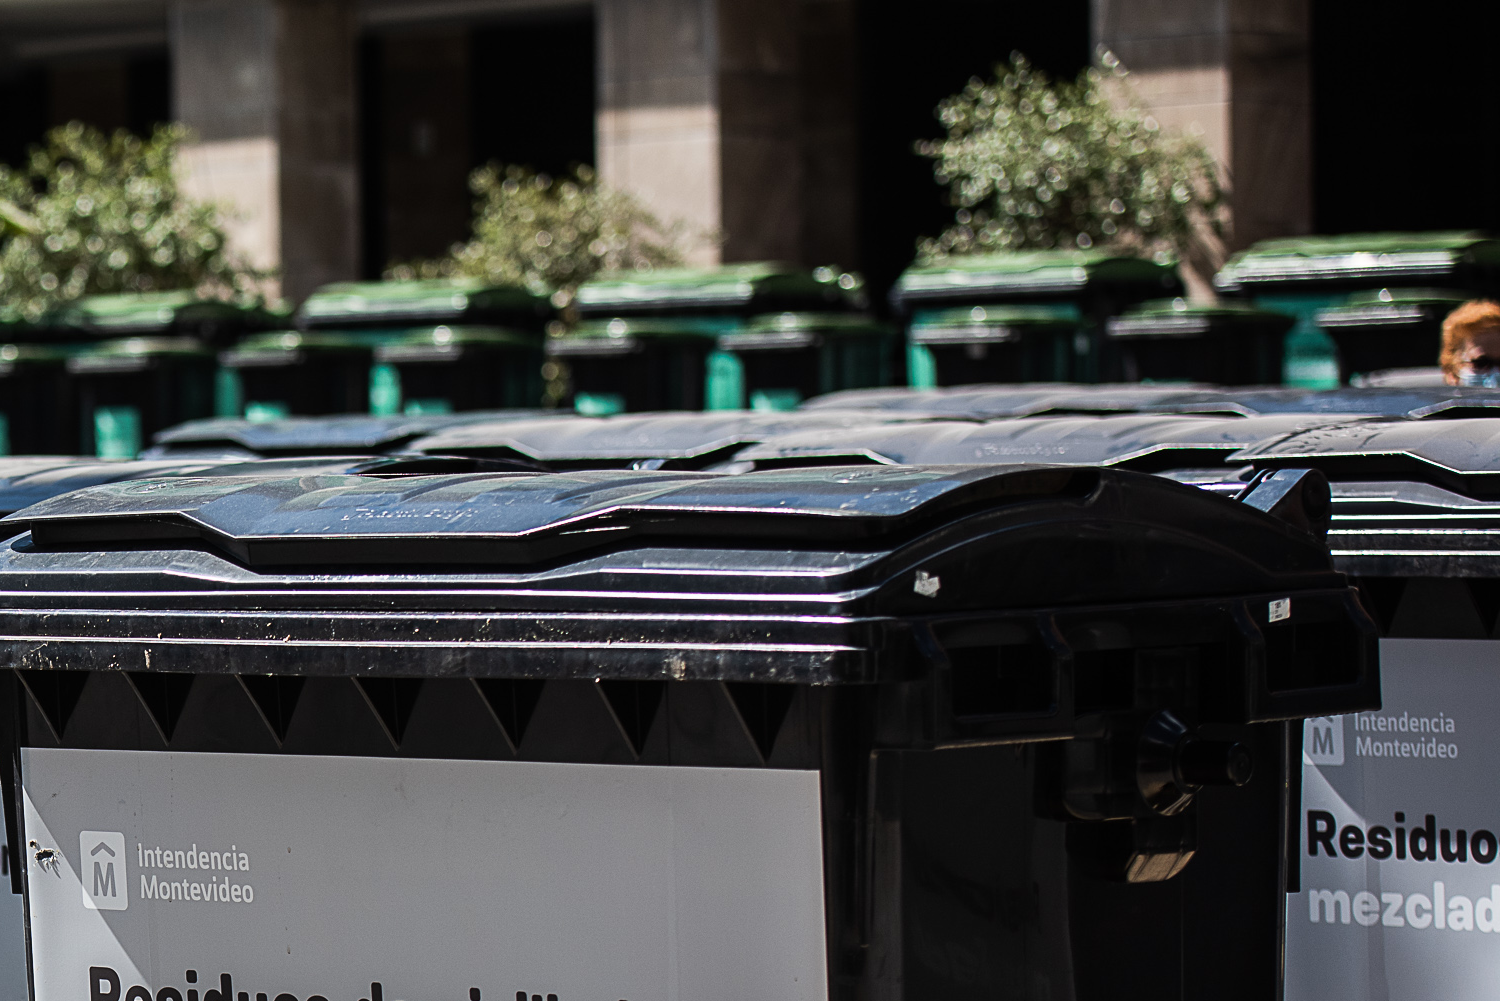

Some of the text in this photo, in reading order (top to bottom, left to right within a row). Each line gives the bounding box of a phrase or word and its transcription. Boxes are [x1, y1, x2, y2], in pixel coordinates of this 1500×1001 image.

[1354, 712, 1456, 733] Intendencia
[1356, 736, 1458, 759] Montevideo
[1307, 810, 1500, 864] Residuo
[137, 843, 250, 871] Intendencia
[140, 874, 254, 903] Montevideo
